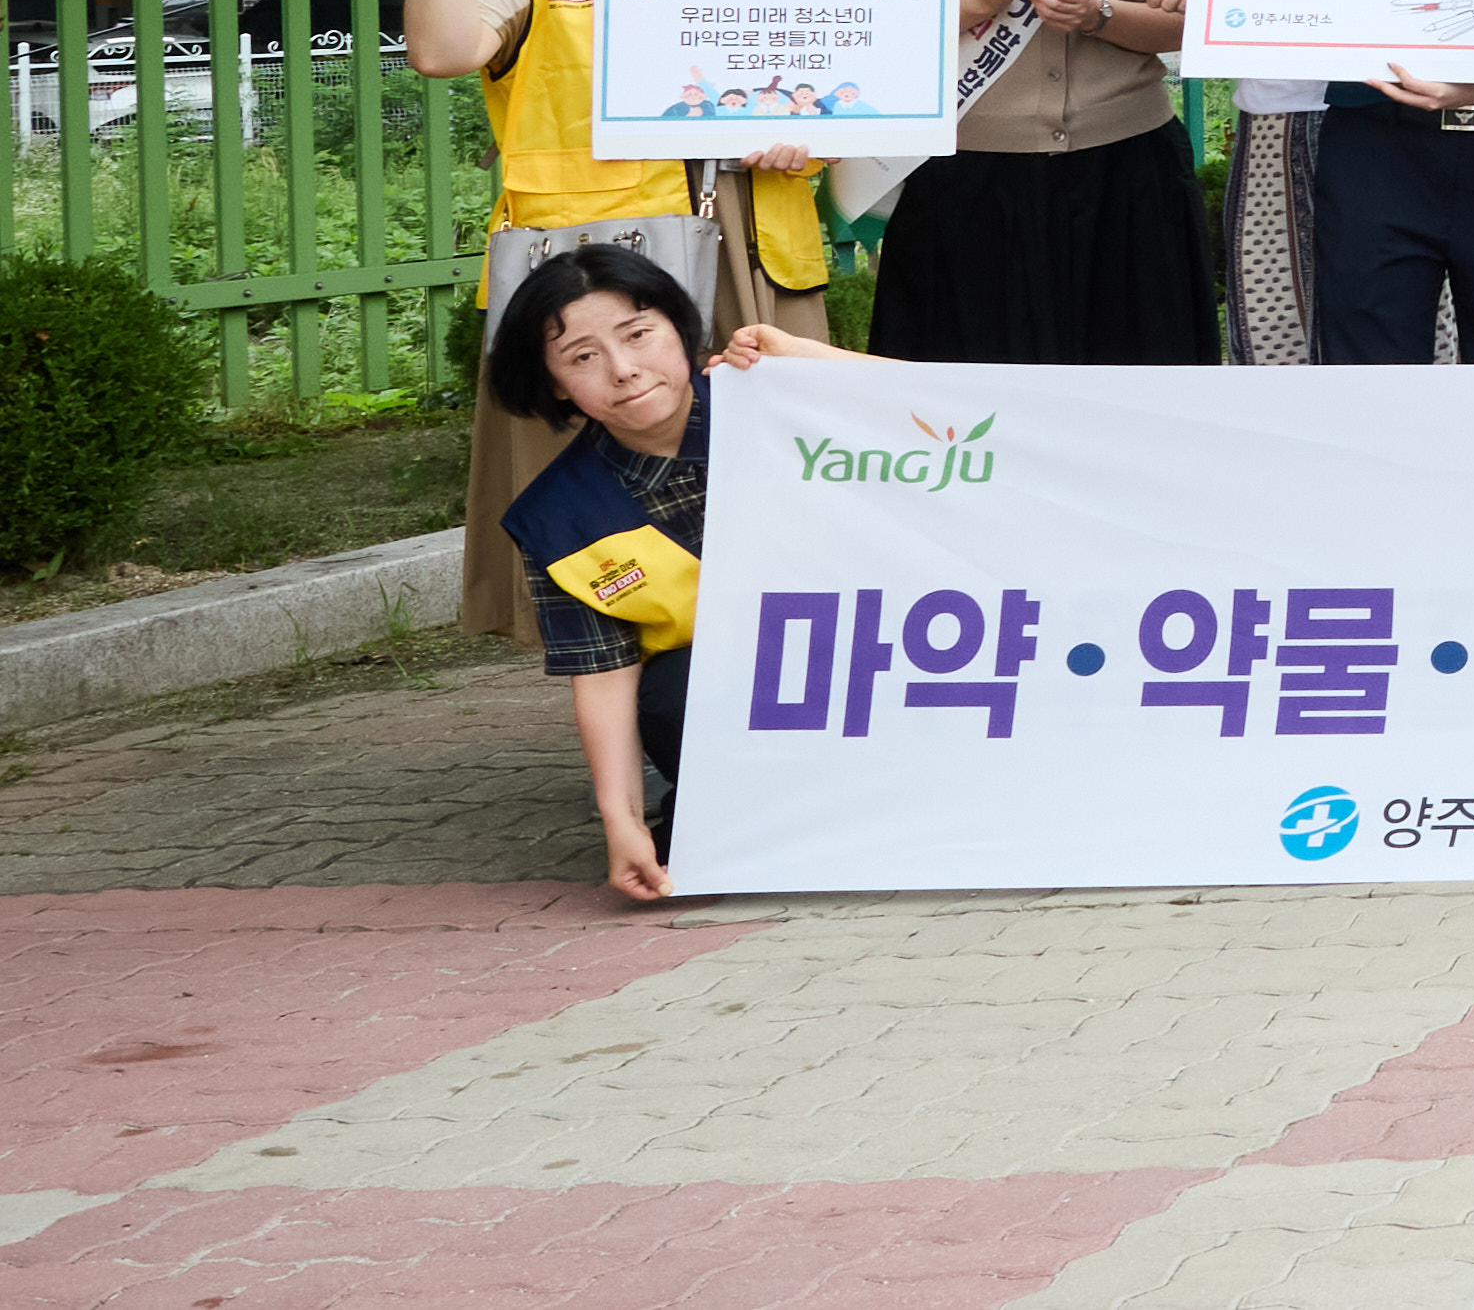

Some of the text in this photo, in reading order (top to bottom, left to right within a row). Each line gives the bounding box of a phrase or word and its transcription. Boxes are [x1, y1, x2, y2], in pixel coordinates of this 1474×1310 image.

[680, 7, 873, 24] 우리의 미래 청소년이
[1252, 12, 1333, 27] 양주시보건소
[680, 30, 872, 47] 마약으로 병들지 않게
[727, 54, 832, 71] 도와주세요!
[958, 24, 1021, 109] 함께합
[794, 410, 996, 492] Yangju
